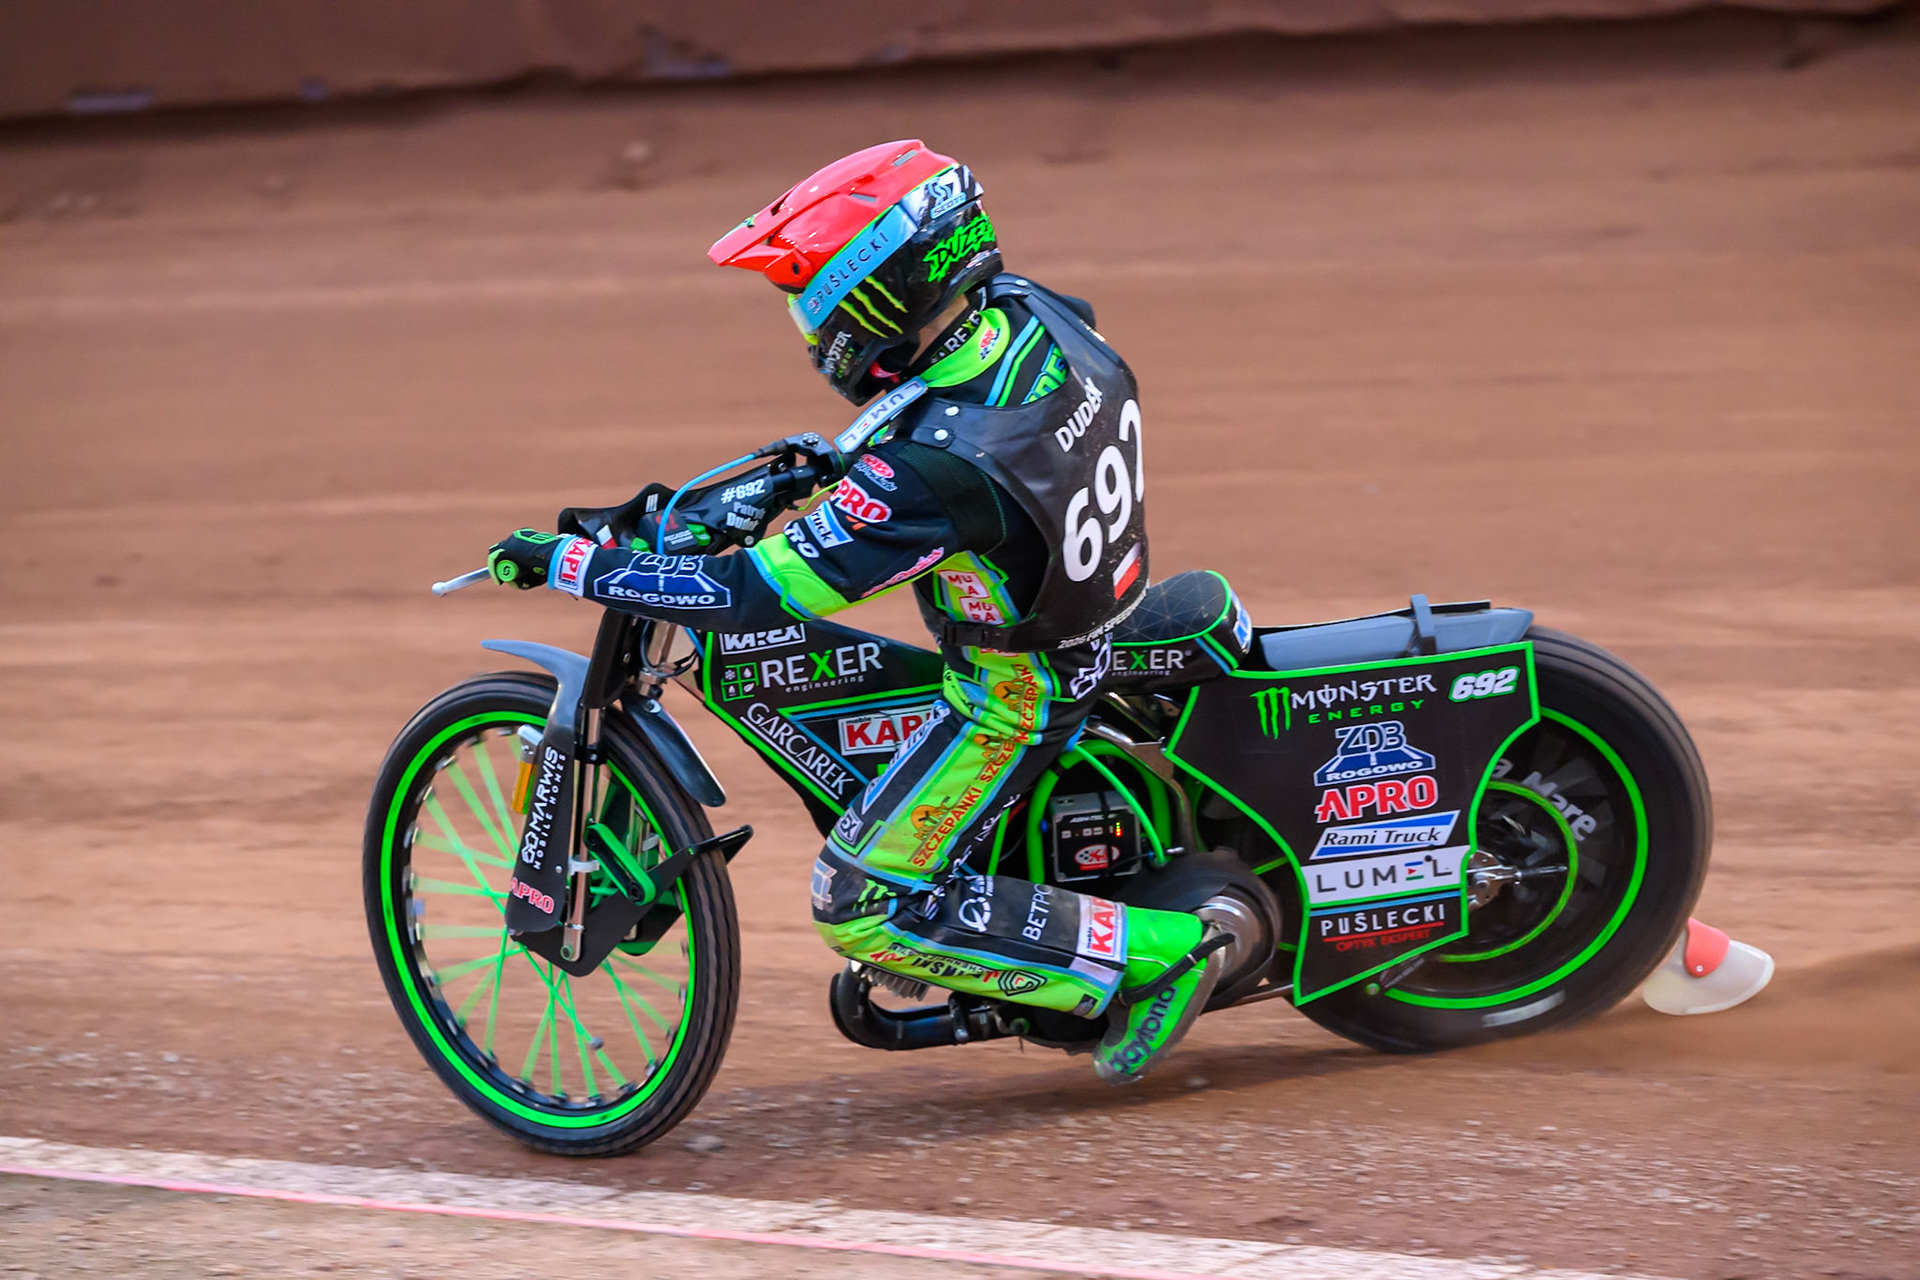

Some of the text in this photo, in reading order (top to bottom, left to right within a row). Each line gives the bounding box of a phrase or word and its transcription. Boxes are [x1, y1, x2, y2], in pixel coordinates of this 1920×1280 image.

[720, 479, 766, 504] #692
[832, 476, 892, 523] PRO
[812, 508, 834, 542] ruck
[608, 586, 716, 605] ROGOWO
[760, 642, 884, 689] REXER
[1108, 648, 1185, 671] EXER
[785, 674, 865, 694] engineering
[1291, 668, 1519, 711] MONSTER 692
[846, 712, 932, 748] KAP
[1308, 699, 1425, 725] ENERGY
[747, 702, 855, 799] GARCAREK
[1335, 720, 1407, 757] ZDB
[1326, 760, 1424, 782] ROGOWO
[1314, 775, 1439, 823] APRO
[912, 786, 983, 867] SZCZEPANKI
[1323, 827, 1441, 847] Rami Truck
[1316, 859, 1453, 894] LUMEL
[510, 876, 555, 915] APRO
[1110, 986, 1177, 1074] daytona
